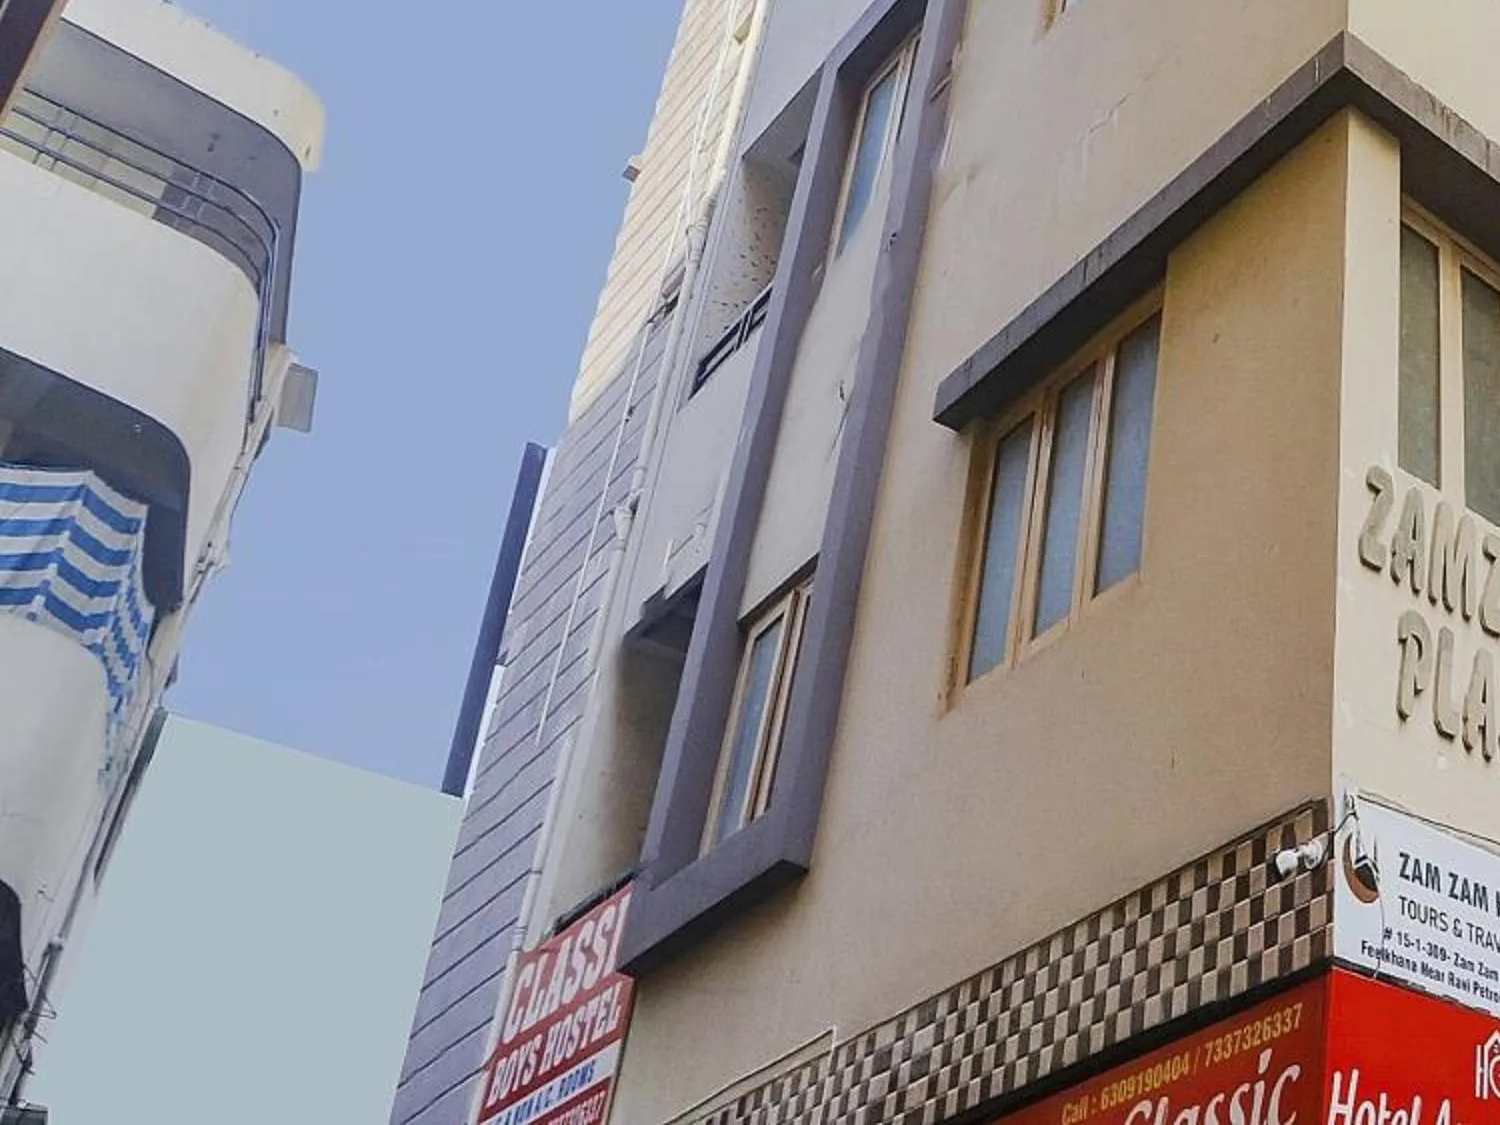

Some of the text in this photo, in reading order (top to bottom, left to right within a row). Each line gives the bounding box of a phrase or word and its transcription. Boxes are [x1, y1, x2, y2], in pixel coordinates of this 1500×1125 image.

[1399, 852, 1442, 893] ZAM
[1448, 872, 1490, 914] ZAM
[1399, 896, 1448, 932] TOURS
[1453, 918, 1463, 938] &
[1420, 961, 1446, 982] Near
[1447, 972, 1471, 992] Ravi
[1453, 952, 1475, 972] Zam
[1478, 961, 1500, 982] Zam
[486, 1034, 543, 1108] BOYS
[538, 981, 623, 1075] HOSTEL
[1204, 1003, 1304, 1068] 7337326337
